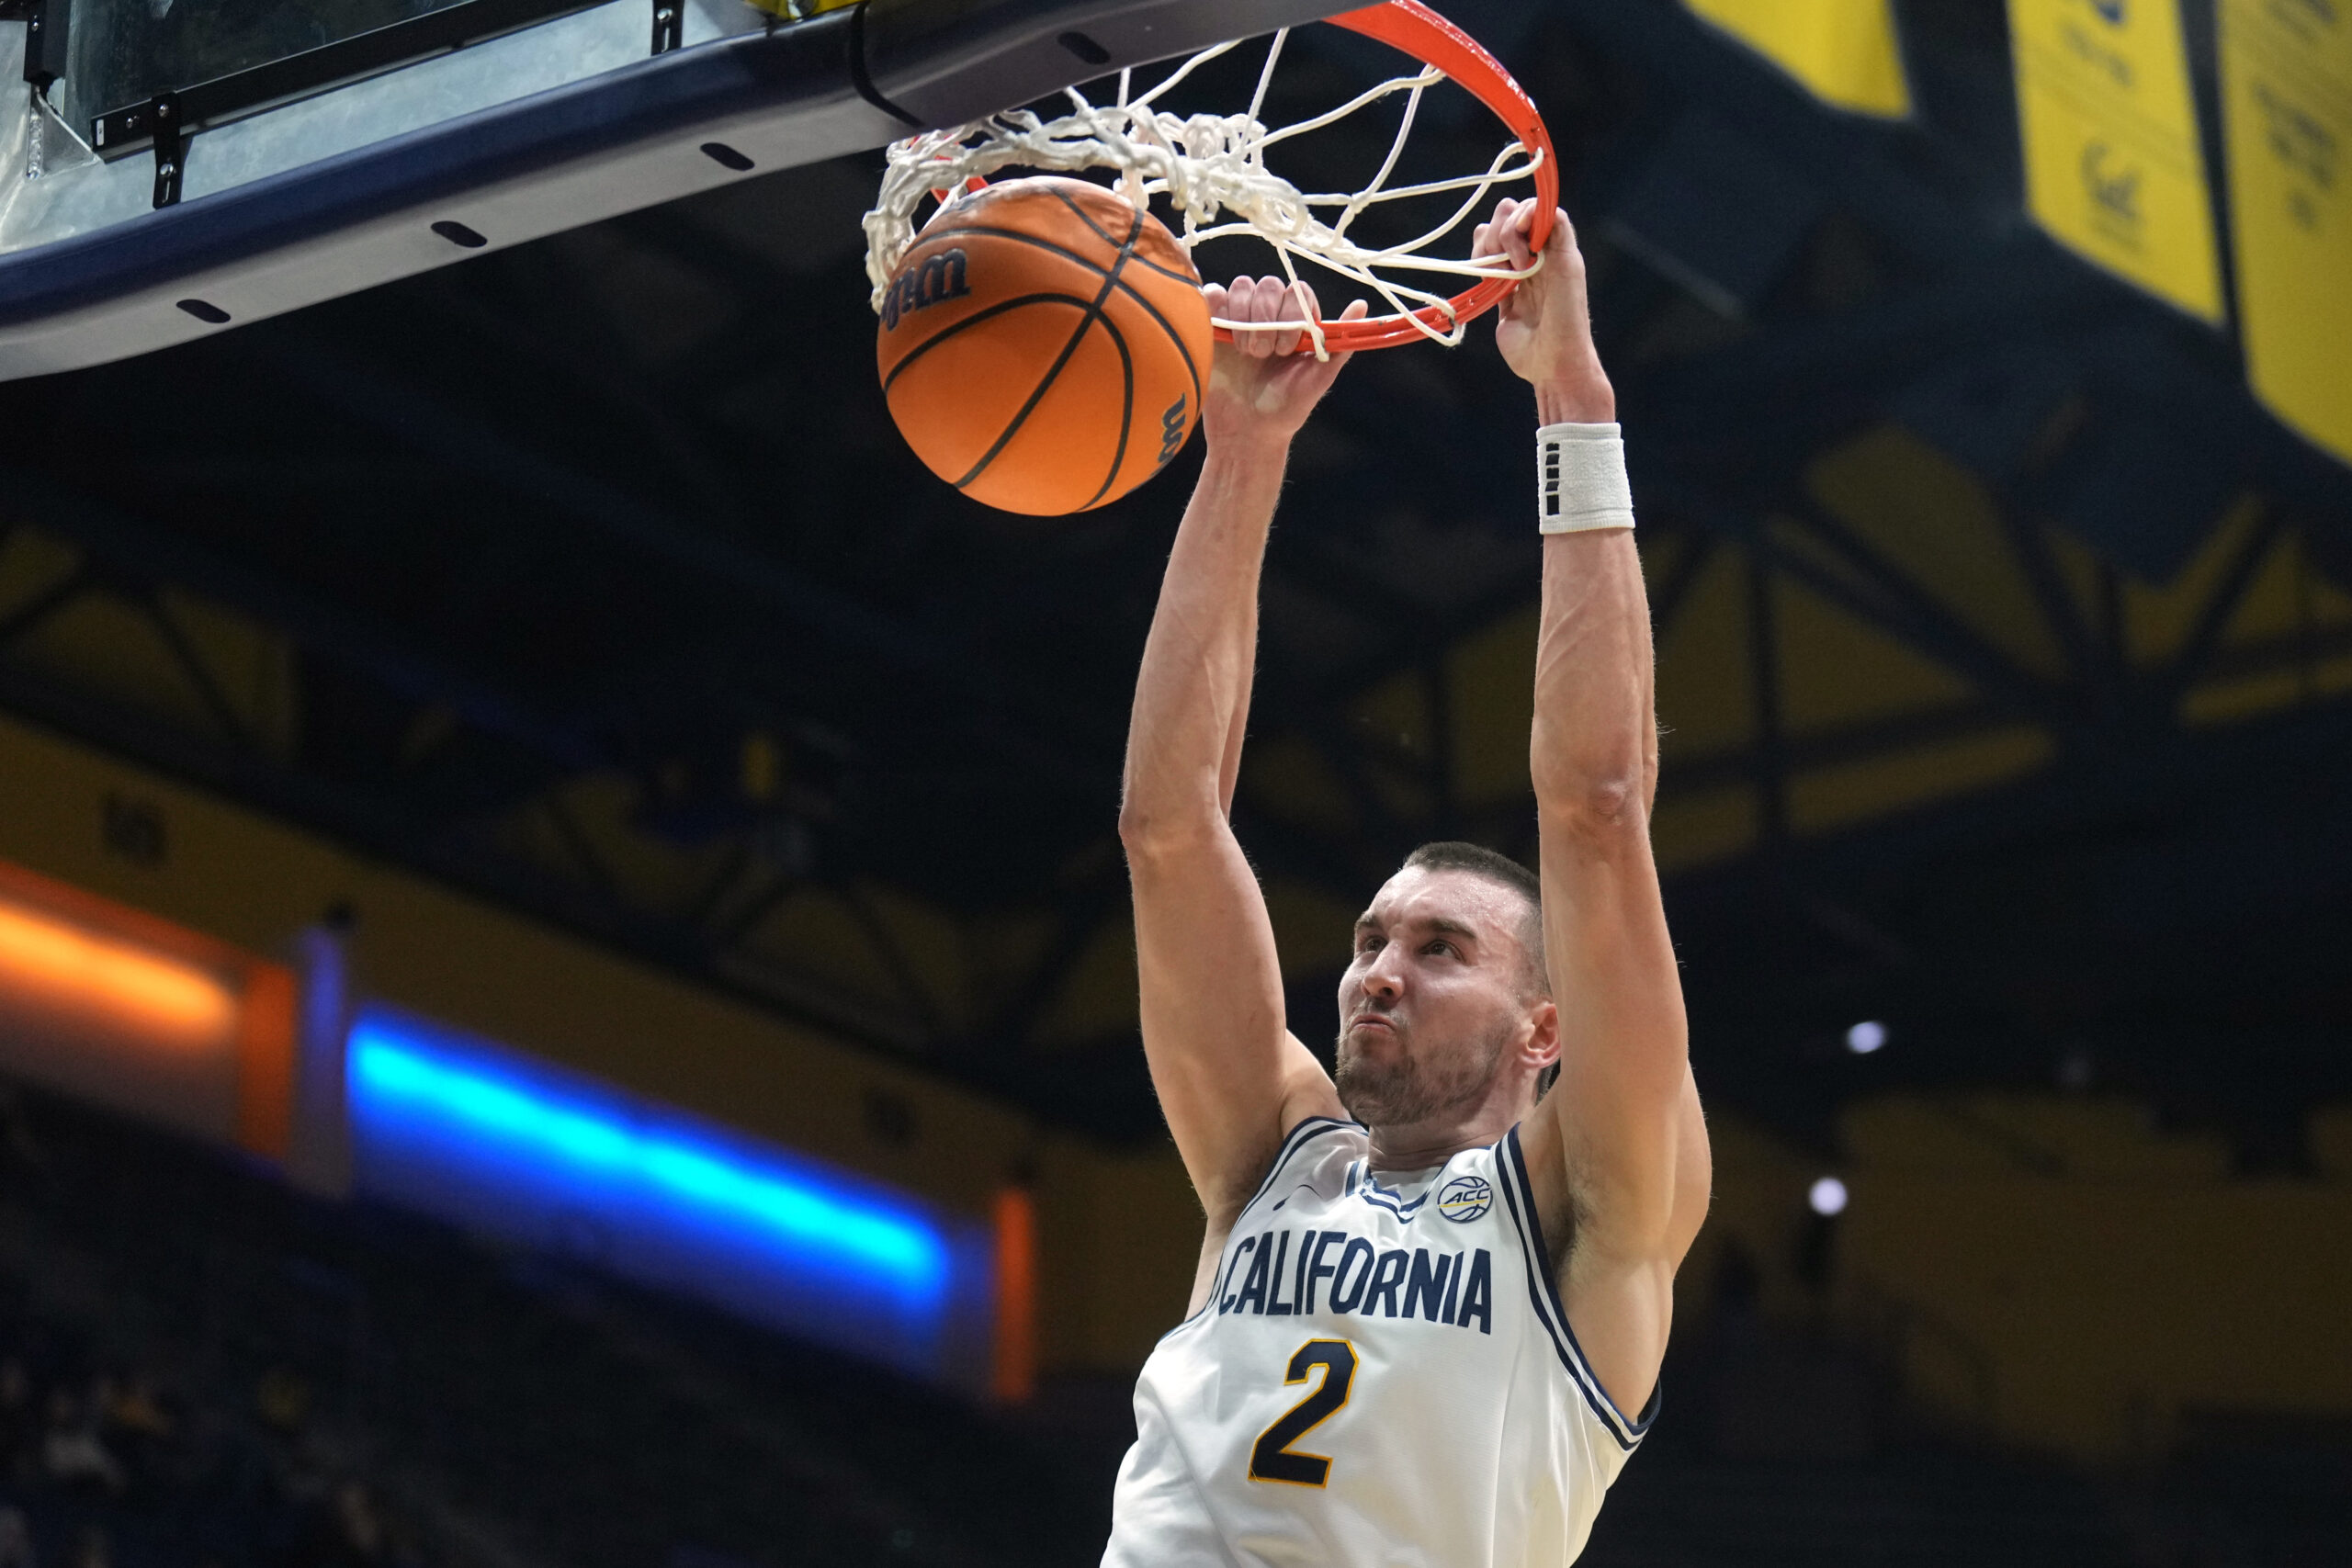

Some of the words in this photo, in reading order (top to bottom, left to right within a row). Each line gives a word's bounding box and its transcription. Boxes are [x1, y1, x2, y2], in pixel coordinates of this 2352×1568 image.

[1443, 1187, 1491, 1204] ACC
[1217, 1229, 1491, 1336] CALIFORNIA
[1248, 1337, 1360, 1489] 2
